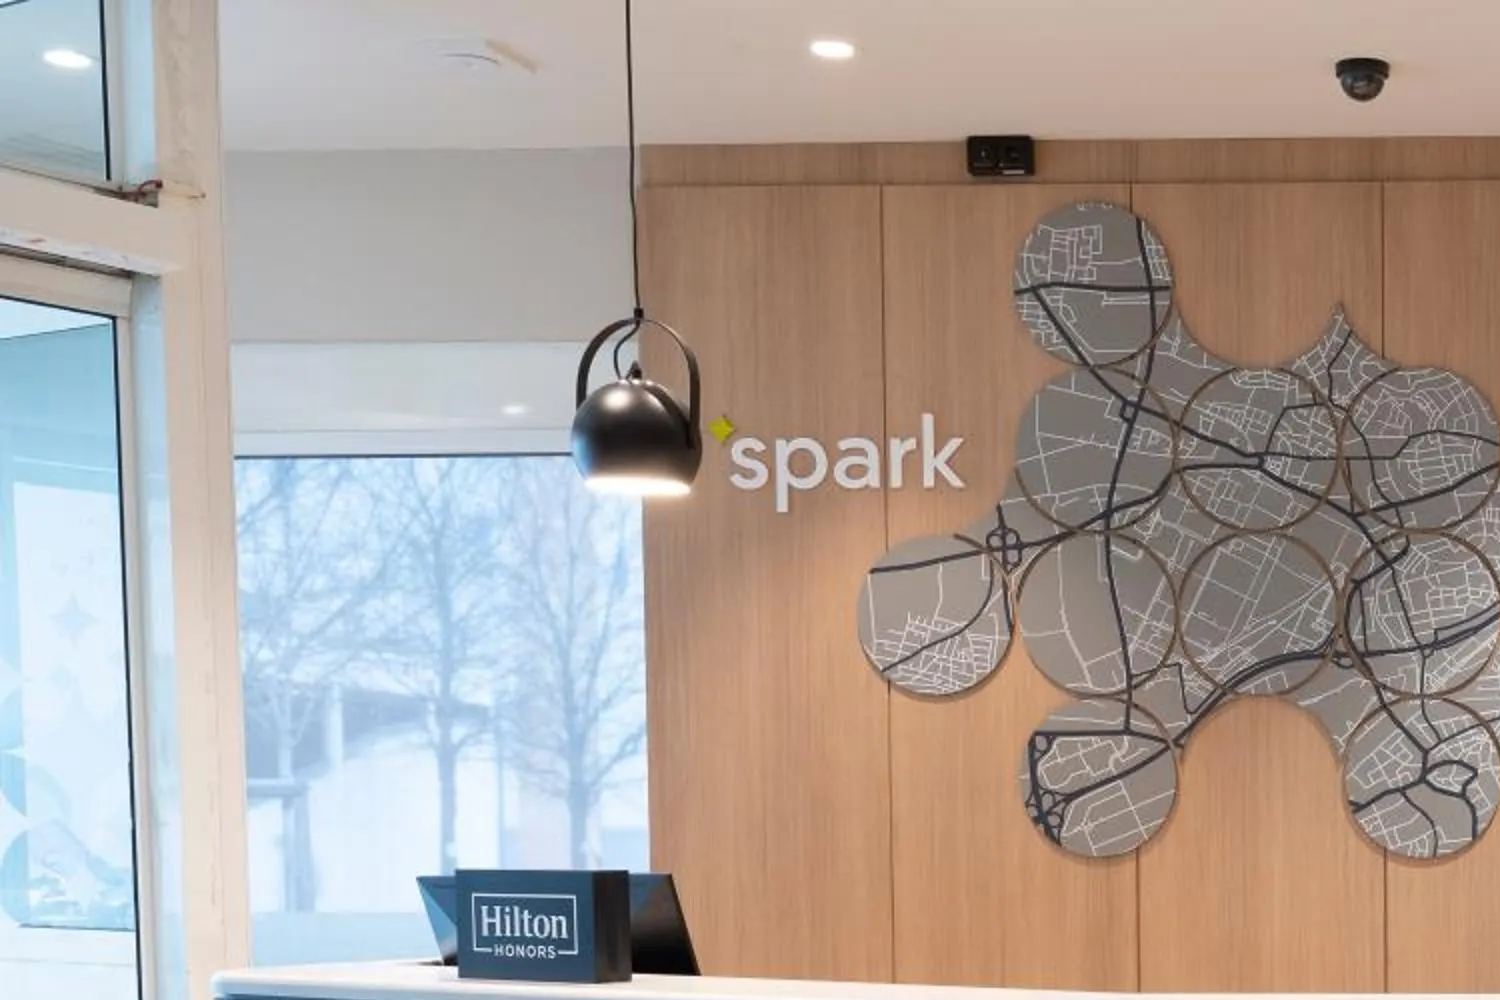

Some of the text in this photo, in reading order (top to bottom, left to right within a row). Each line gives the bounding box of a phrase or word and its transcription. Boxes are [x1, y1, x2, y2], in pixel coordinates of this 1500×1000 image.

[730, 412, 966, 513] spark
[480, 904, 569, 940] Hilton
[493, 943, 557, 959] HONORS
